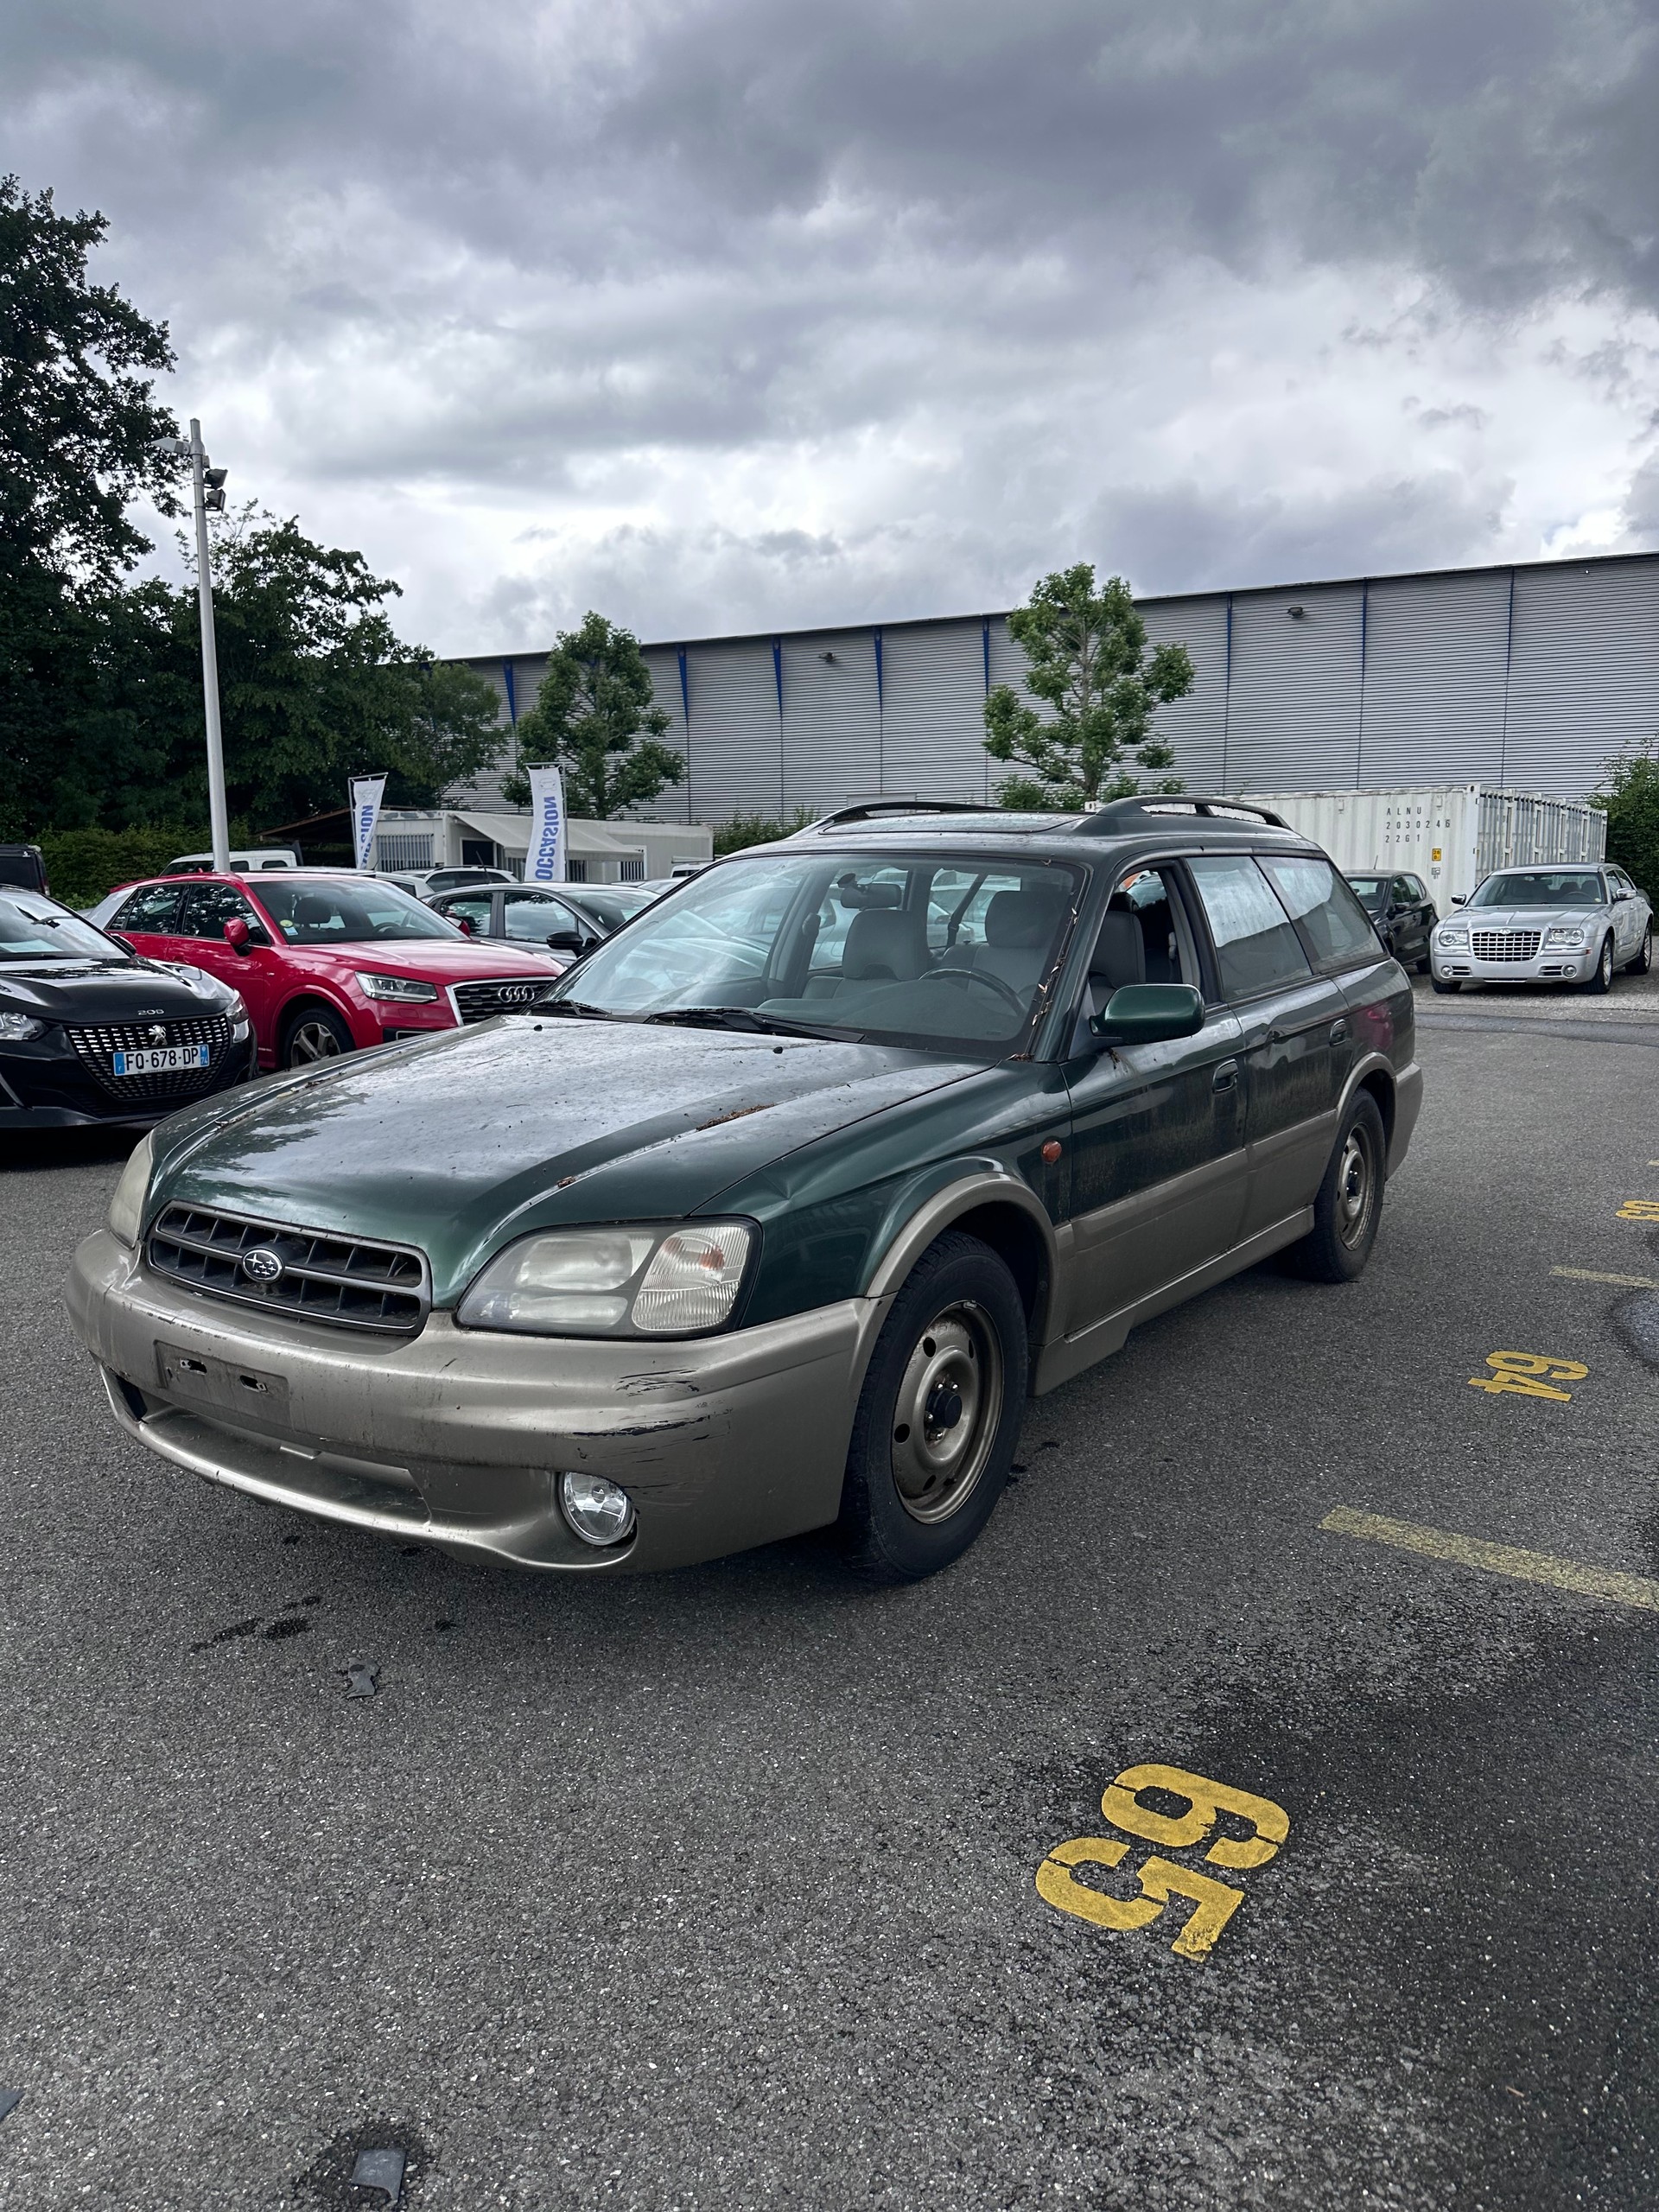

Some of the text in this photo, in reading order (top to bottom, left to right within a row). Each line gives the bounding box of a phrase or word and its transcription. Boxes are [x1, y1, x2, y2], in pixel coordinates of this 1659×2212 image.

[1386, 806, 1421, 816] ALNU
[1385, 818, 1451, 830] 2030246
[1385, 834, 1421, 843] 22G1
[125, 1047, 199, 1071] FQ-678-DP
[1468, 1351, 1589, 1402] 64
[1035, 1764, 1290, 1962] 65
